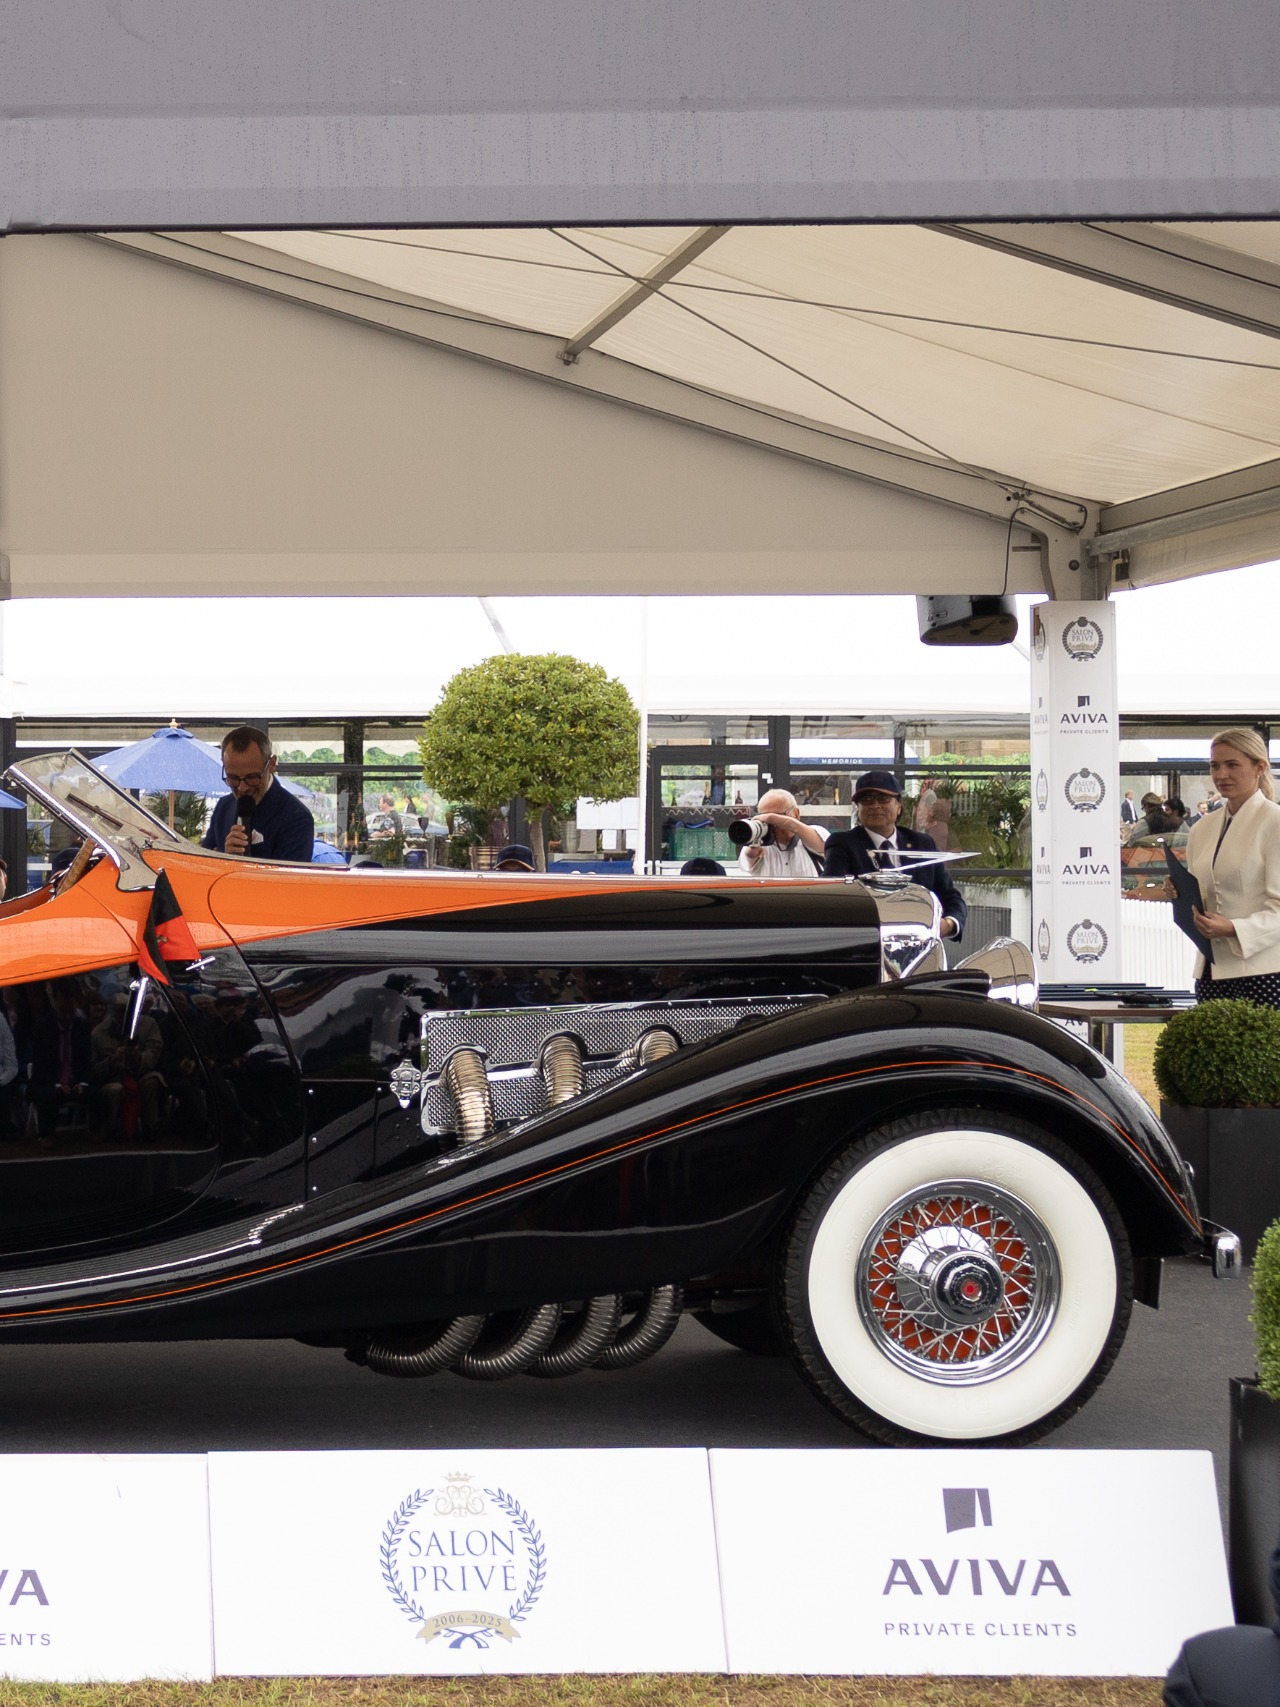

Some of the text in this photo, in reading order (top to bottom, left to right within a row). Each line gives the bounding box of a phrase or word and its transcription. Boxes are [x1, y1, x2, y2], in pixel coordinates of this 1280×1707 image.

[1060, 713, 1108, 724] AVIVA
[1062, 864, 1110, 875] AVIVA
[408, 1530, 514, 1557] SALON
[410, 1560, 517, 1592] PRIVÉ
[882, 1558, 1072, 1596] AVIVA
[884, 1623, 1077, 1636] PRIVATE CLIENTS
